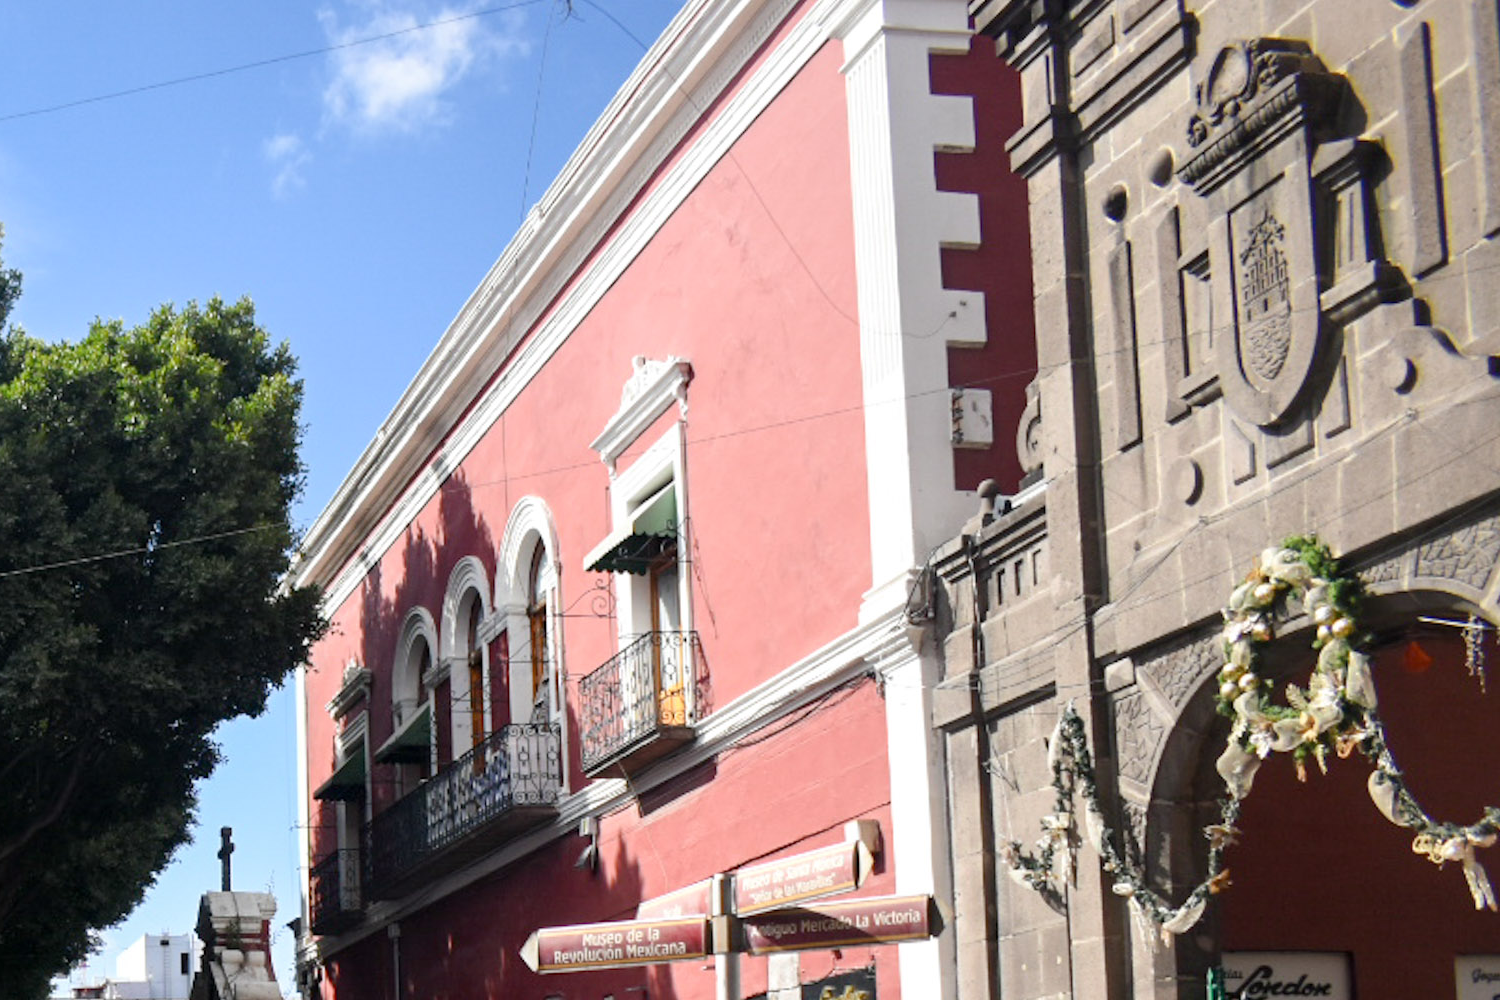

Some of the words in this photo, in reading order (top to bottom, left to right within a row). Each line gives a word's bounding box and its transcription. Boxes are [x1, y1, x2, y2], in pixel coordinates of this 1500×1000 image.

[742, 876, 770, 892] Museo
[750, 922, 797, 940] Antiguo
[801, 915, 852, 934] Mercado
[855, 914, 870, 928] La
[873, 909, 922, 927] Victoria
[582, 932, 622, 947] Museo
[626, 929, 643, 943] de
[647, 928, 660, 941] la
[554, 945, 623, 965] Revolución
[626, 941, 686, 959] Mexicana
